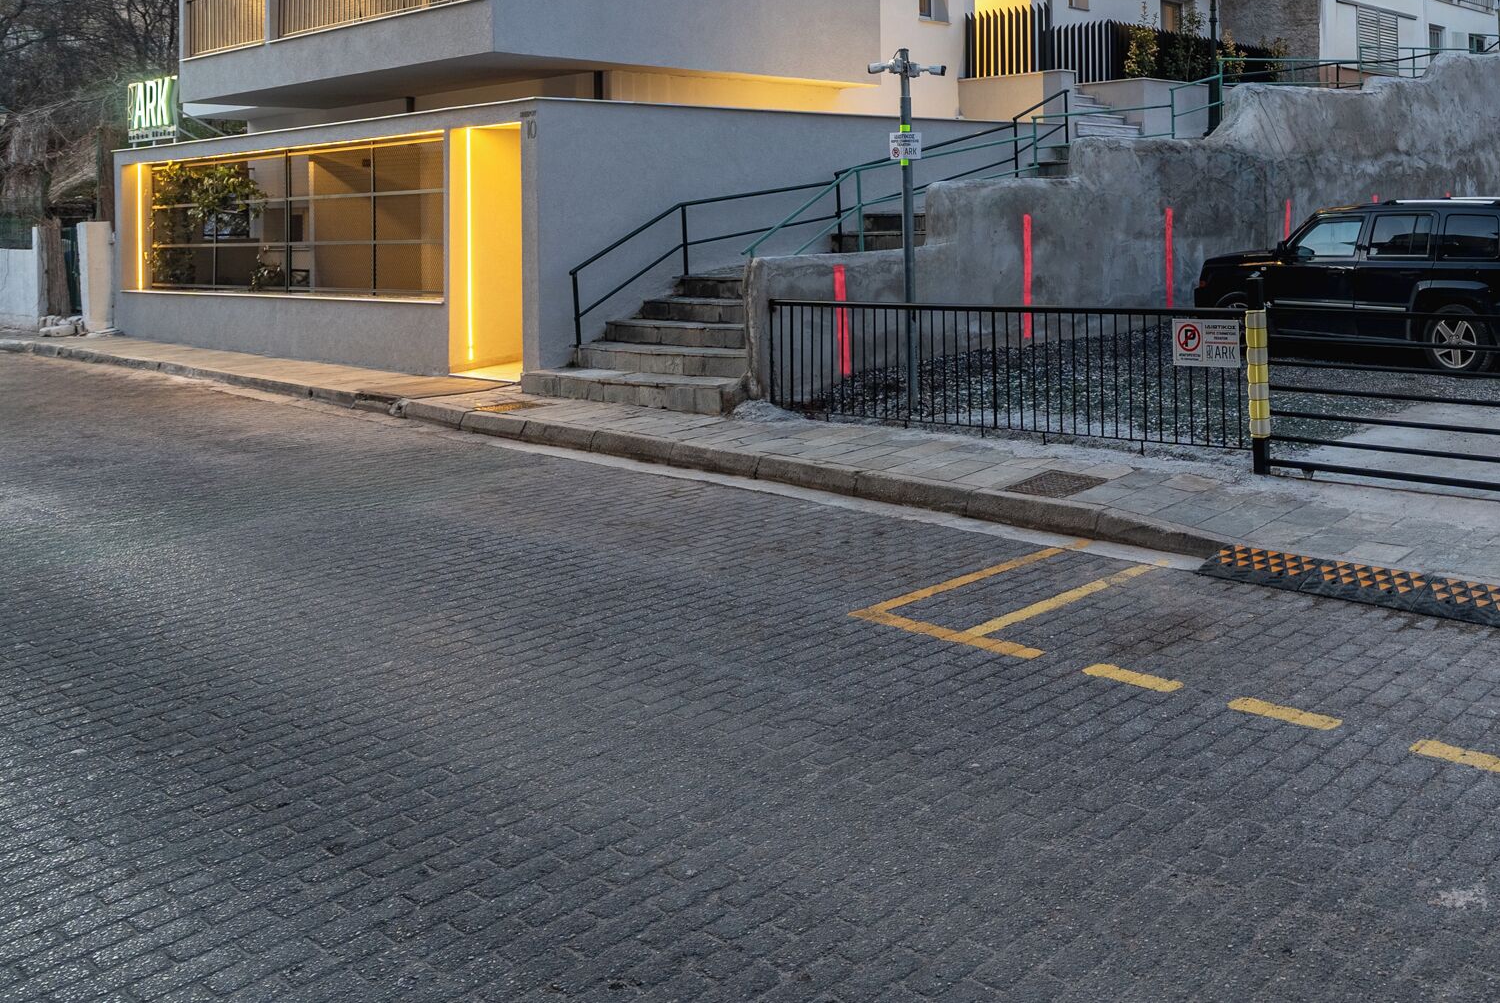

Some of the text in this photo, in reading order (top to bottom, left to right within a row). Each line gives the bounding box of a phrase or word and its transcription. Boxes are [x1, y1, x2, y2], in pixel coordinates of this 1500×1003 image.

[133, 75, 178, 130] ARK
[904, 147, 917, 156] ARK
[1214, 345, 1236, 359] ARK
